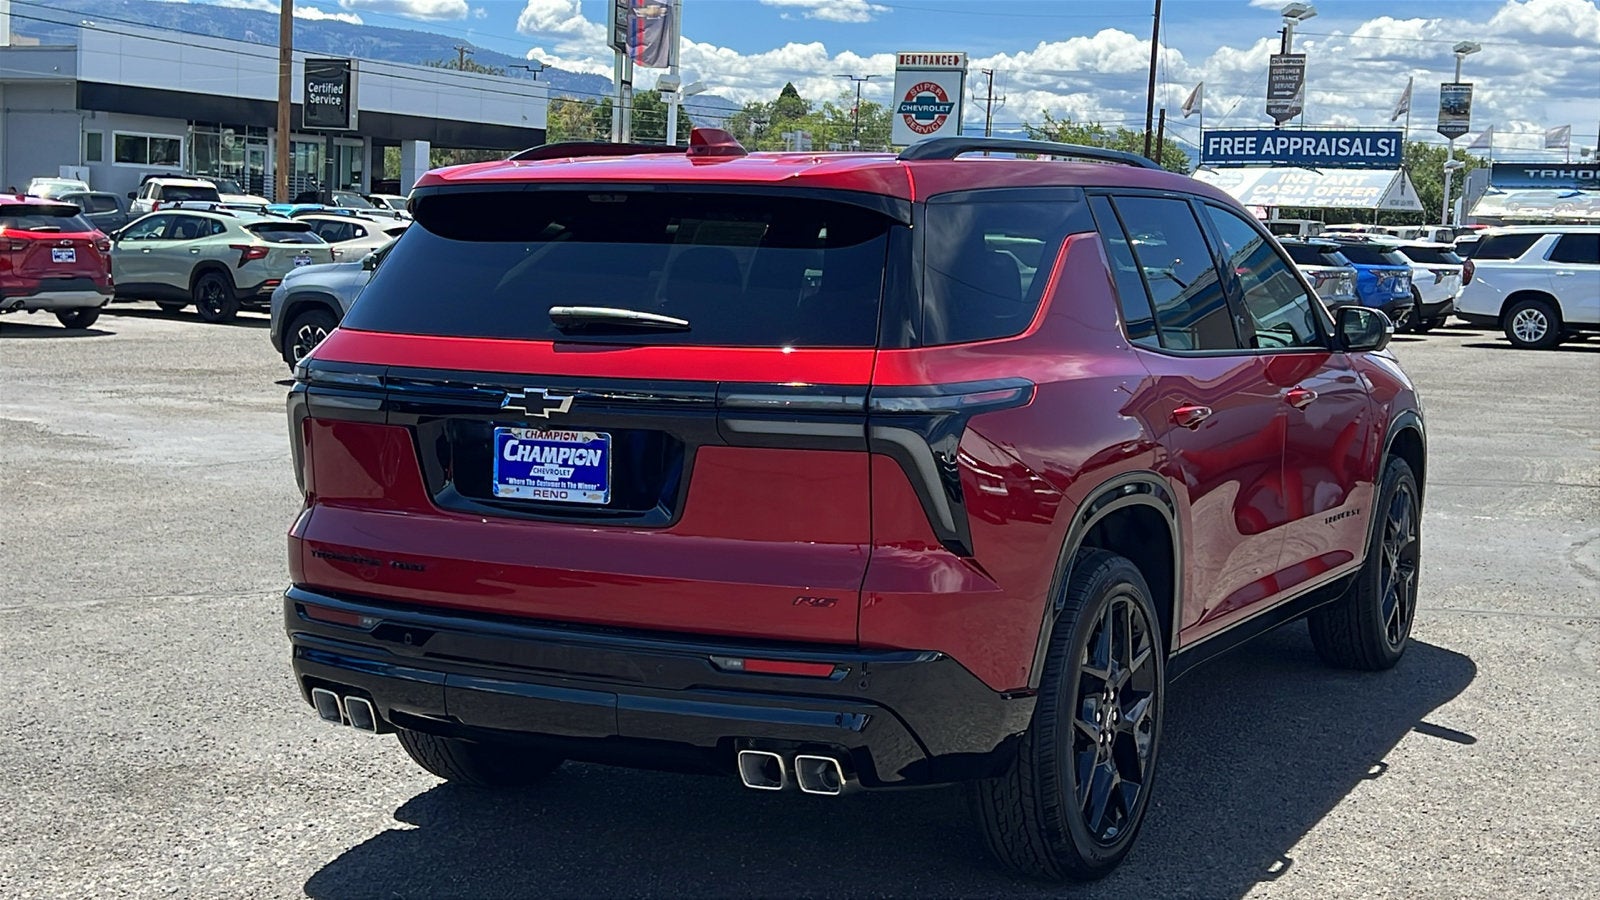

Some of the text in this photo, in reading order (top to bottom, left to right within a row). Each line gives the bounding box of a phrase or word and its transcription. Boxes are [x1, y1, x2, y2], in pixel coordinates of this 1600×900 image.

[905, 55, 953, 66] ENTRANCE
[308, 82, 344, 94] Certified
[910, 83, 943, 97] SUPER
[309, 93, 342, 105] Service
[901, 104, 951, 112] CHEVROLET
[905, 116, 943, 134] SERVICE
[1209, 137, 1396, 157] FREE APPRAISALS!
[1278, 173, 1370, 185] INSTANT
[1523, 169, 1600, 179] TAHO
[1252, 184, 1380, 198] CASH OFFER
[525, 429, 579, 441] CHAMPION
[503, 439, 603, 467] CHAMPION
[532, 467, 571, 476] CHEVROLET
[526, 478, 536, 486] The
[536, 479, 561, 488] Customer
[567, 481, 577, 489] The
[533, 489, 569, 499] RENO
[792, 596, 839, 608] RS
